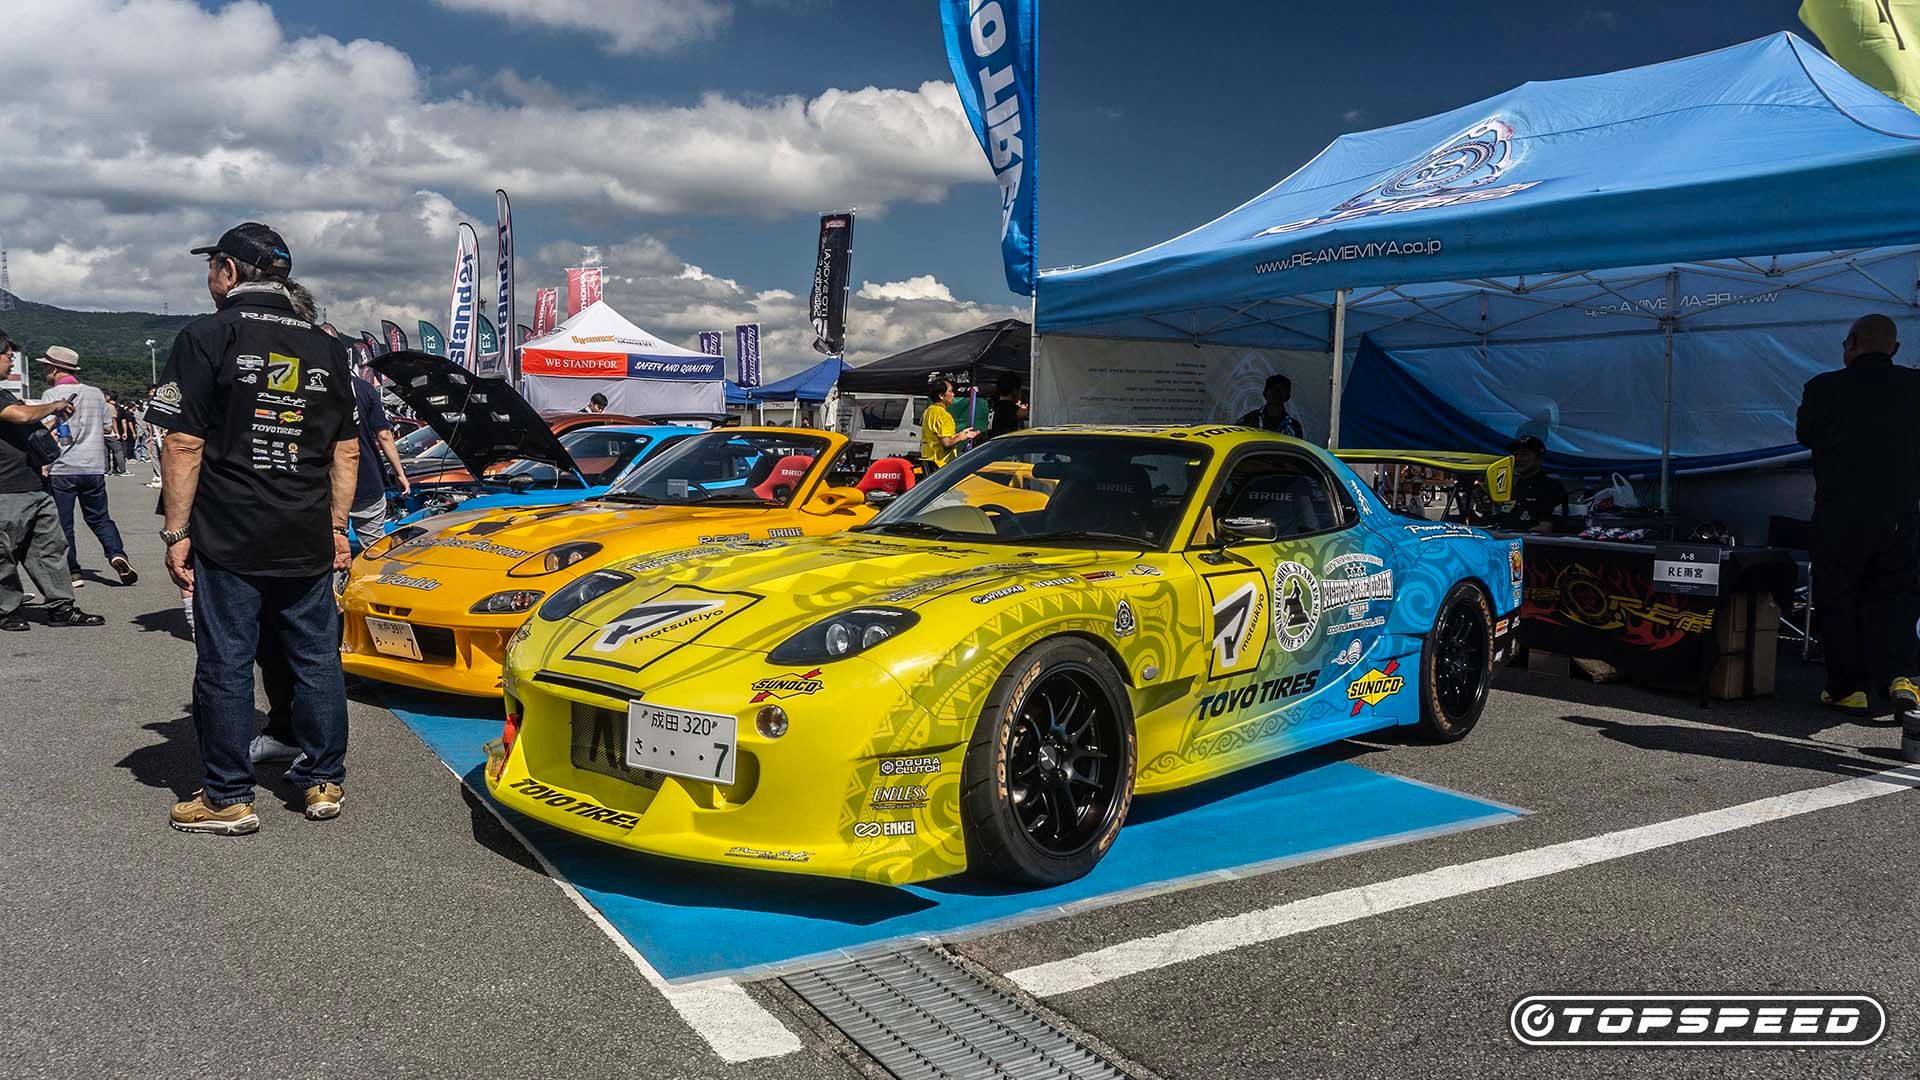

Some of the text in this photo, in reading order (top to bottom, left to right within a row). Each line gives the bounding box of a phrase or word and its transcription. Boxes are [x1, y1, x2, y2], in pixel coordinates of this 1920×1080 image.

[1255, 238, 1442, 275] www.RE-AMEMIYA.co.jp
[545, 358, 618, 370] WE STAND FOR
[635, 361, 664, 372] SAFETY
[664, 363, 680, 373] AND
[252, 424, 302, 436] TOYO TIRES
[782, 469, 804, 477] BRID
[1249, 492, 1293, 501] BRIDE
[769, 527, 803, 538] BRIDE
[1680, 552, 1695, 560] A-8
[1668, 567, 1703, 578] RE雨宮
[632, 609, 724, 644] matsukiyo
[1242, 593, 1264, 653] matsukiyo
[756, 680, 819, 692] SUNOCO
[1350, 678, 1401, 697] SUNOCO
[1198, 670, 1321, 721] TOYO TIRES
[651, 712, 712, 736] 成田 320
[895, 757, 940, 767] OGURA
[895, 765, 940, 774] CLUTCH
[873, 785, 928, 802] ENDLESS
[509, 778, 641, 830] TOYO TIRES
[884, 821, 915, 835] ENKEI
